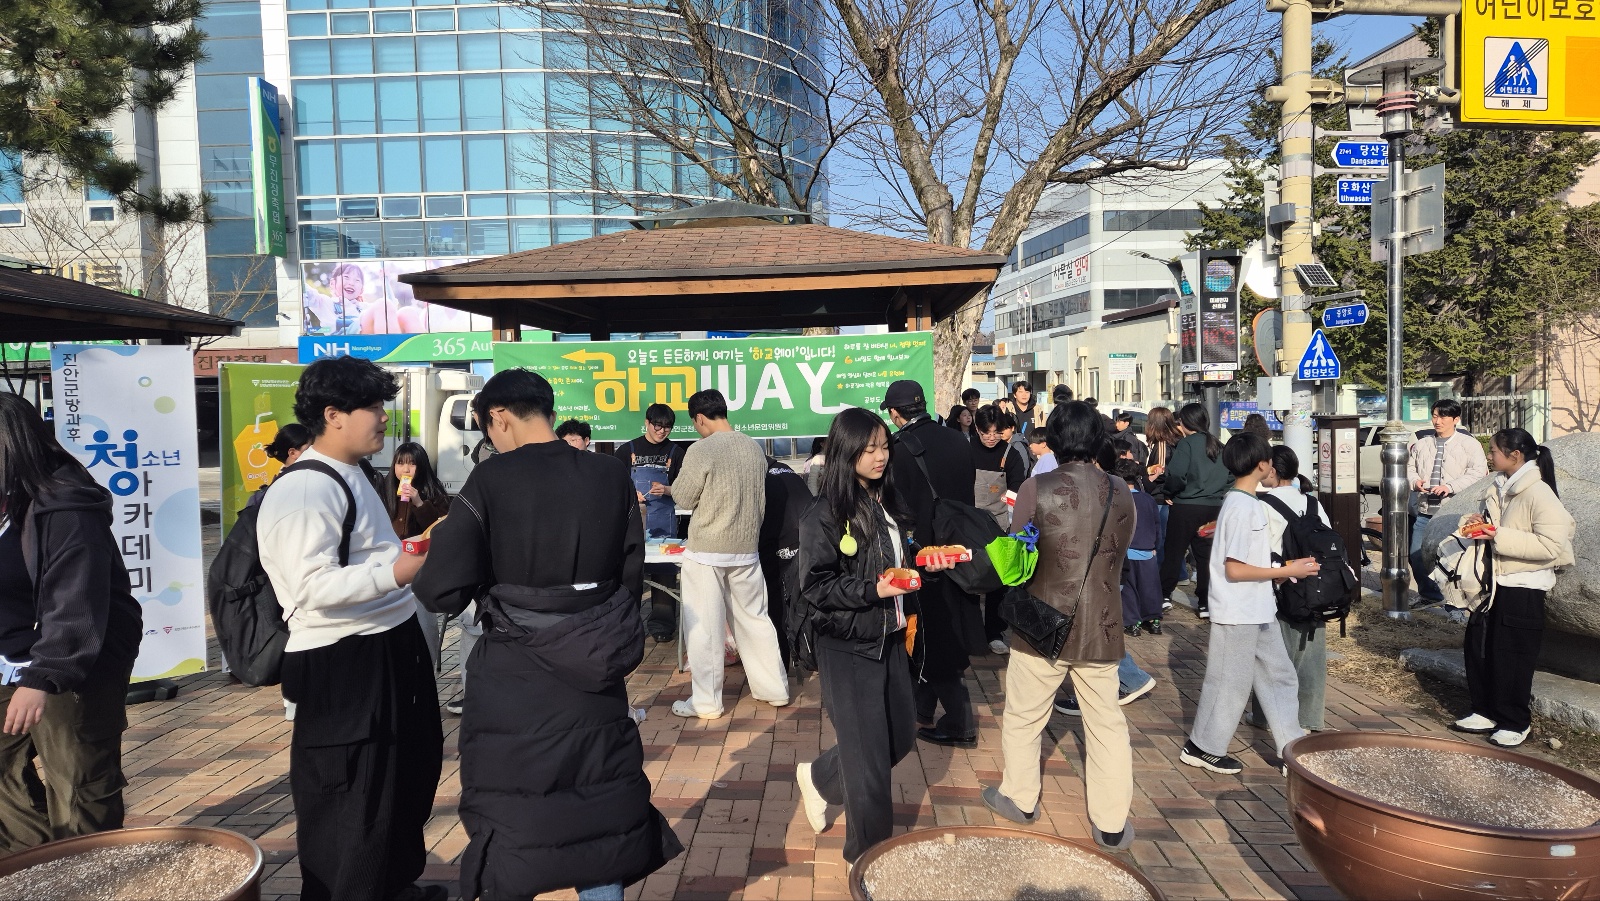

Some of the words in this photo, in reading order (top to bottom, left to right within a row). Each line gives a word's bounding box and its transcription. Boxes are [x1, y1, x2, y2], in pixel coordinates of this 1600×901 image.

[1476, 0, 1596, 21] 어린이보호
[262, 88, 277, 104] NH
[1499, 86, 1533, 94] 어린이보호
[269, 154, 281, 225] 무진장축협
[1341, 182, 1374, 193] 우화산
[272, 229, 284, 243] 365
[1336, 308, 1352, 318] 중앙로
[313, 342, 350, 357] NH
[432, 337, 466, 358] 365
[628, 349, 658, 365] 오늘도
[663, 348, 709, 364] 든든하게!
[712, 348, 744, 362] 여기는
[1303, 367, 1336, 378] 횡단보도
[62, 353, 82, 442] 진안군방과후
